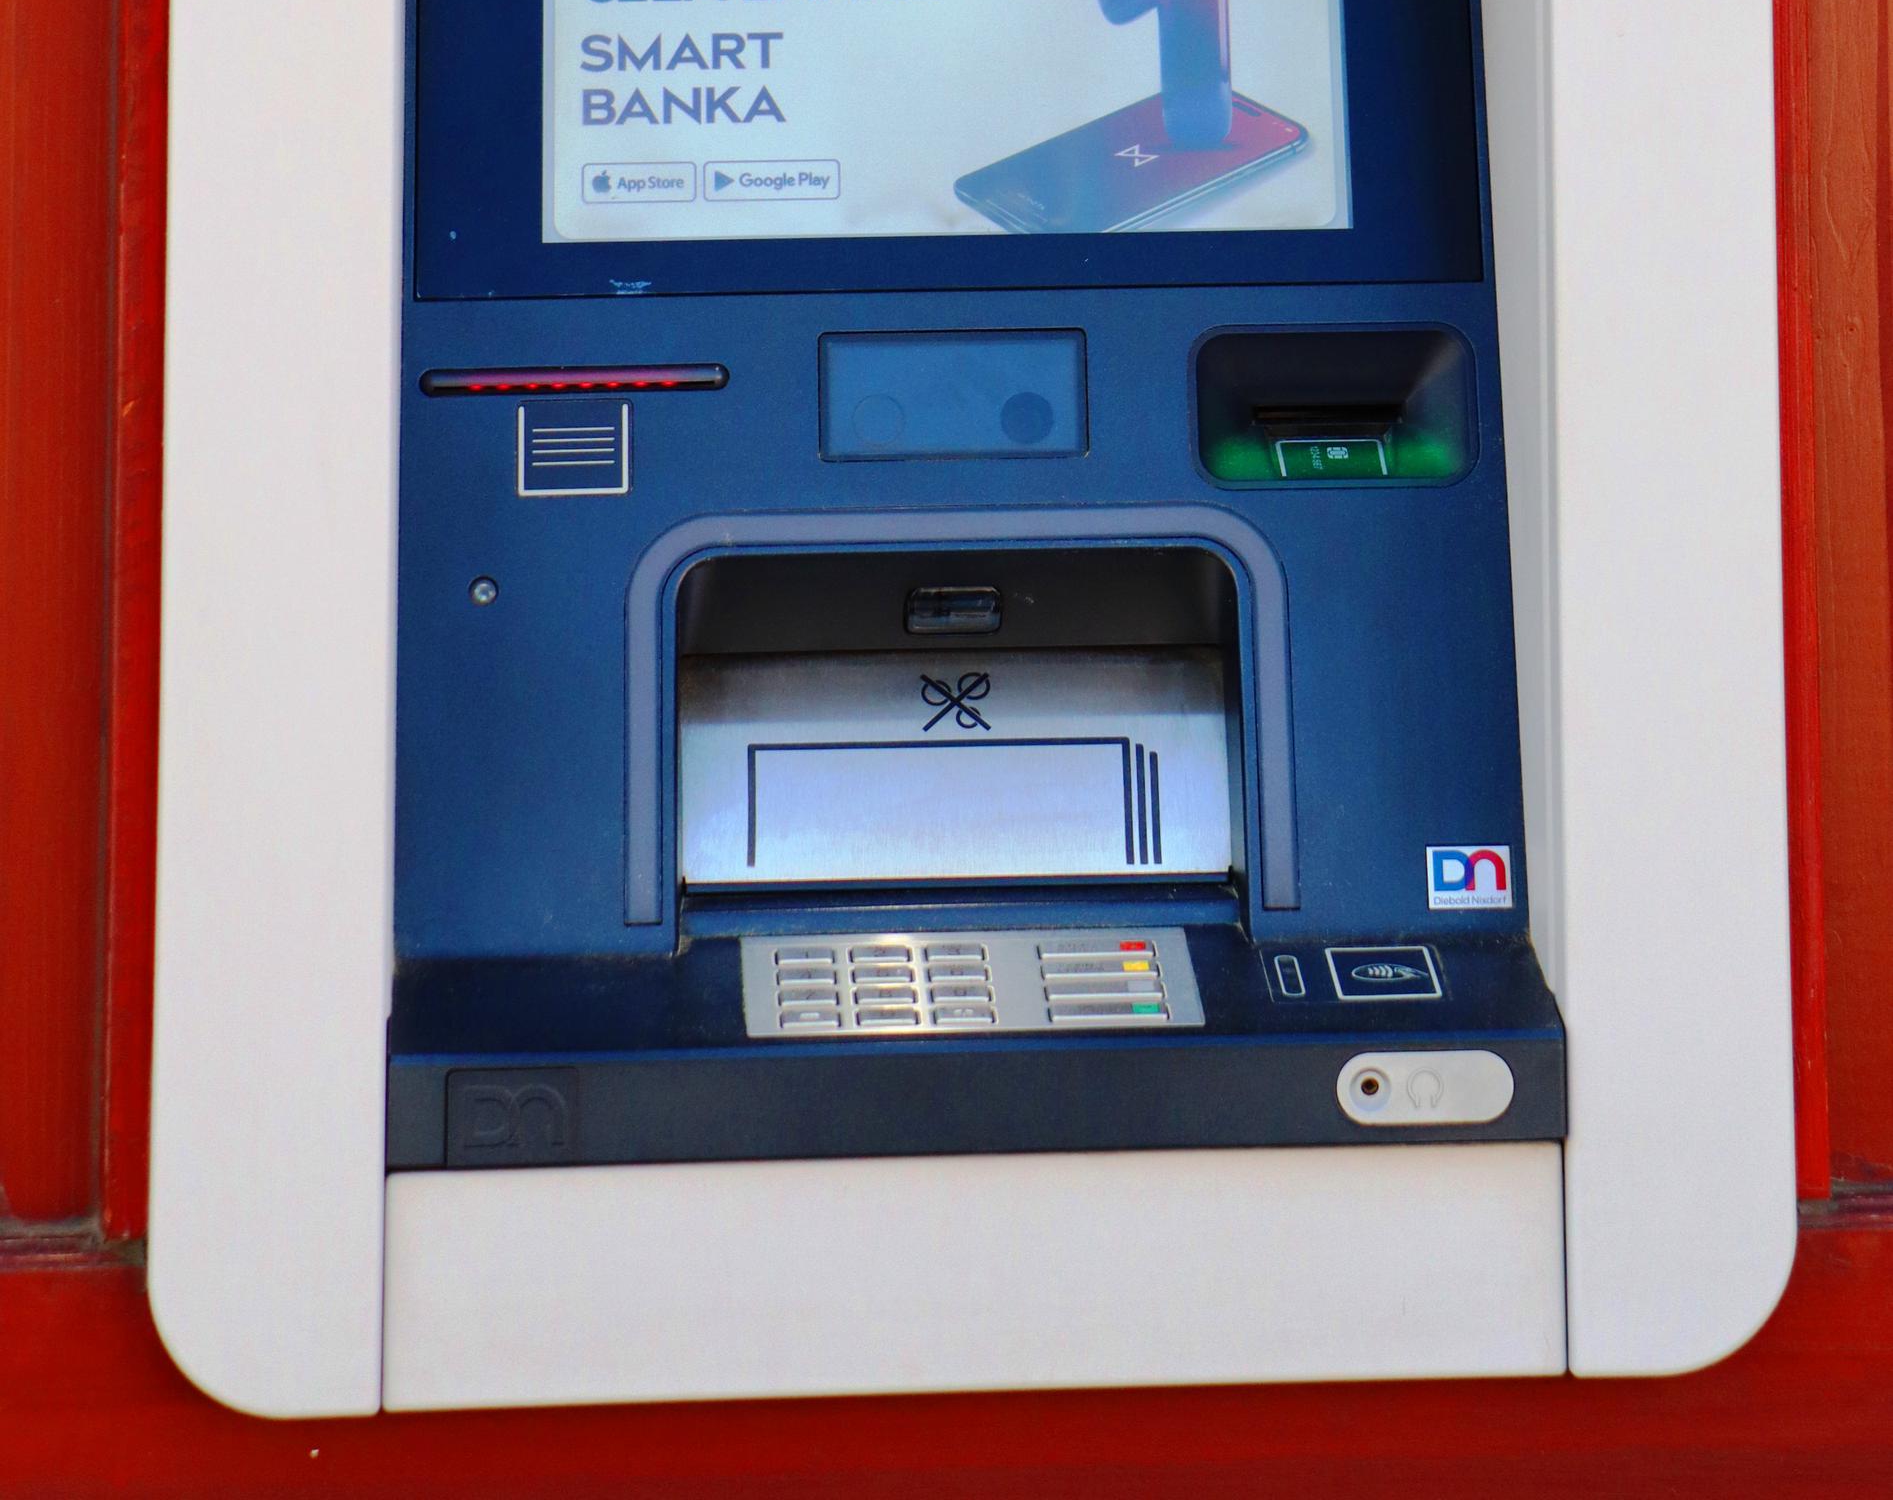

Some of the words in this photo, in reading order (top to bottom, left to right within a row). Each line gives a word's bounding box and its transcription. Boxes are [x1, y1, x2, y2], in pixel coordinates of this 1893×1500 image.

[580, 32, 784, 73] SMART
[581, 85, 787, 126] BANKA
[617, 176, 646, 192] App
[648, 175, 685, 190] Store
[739, 172, 795, 191] Google
[798, 172, 830, 190] Play
